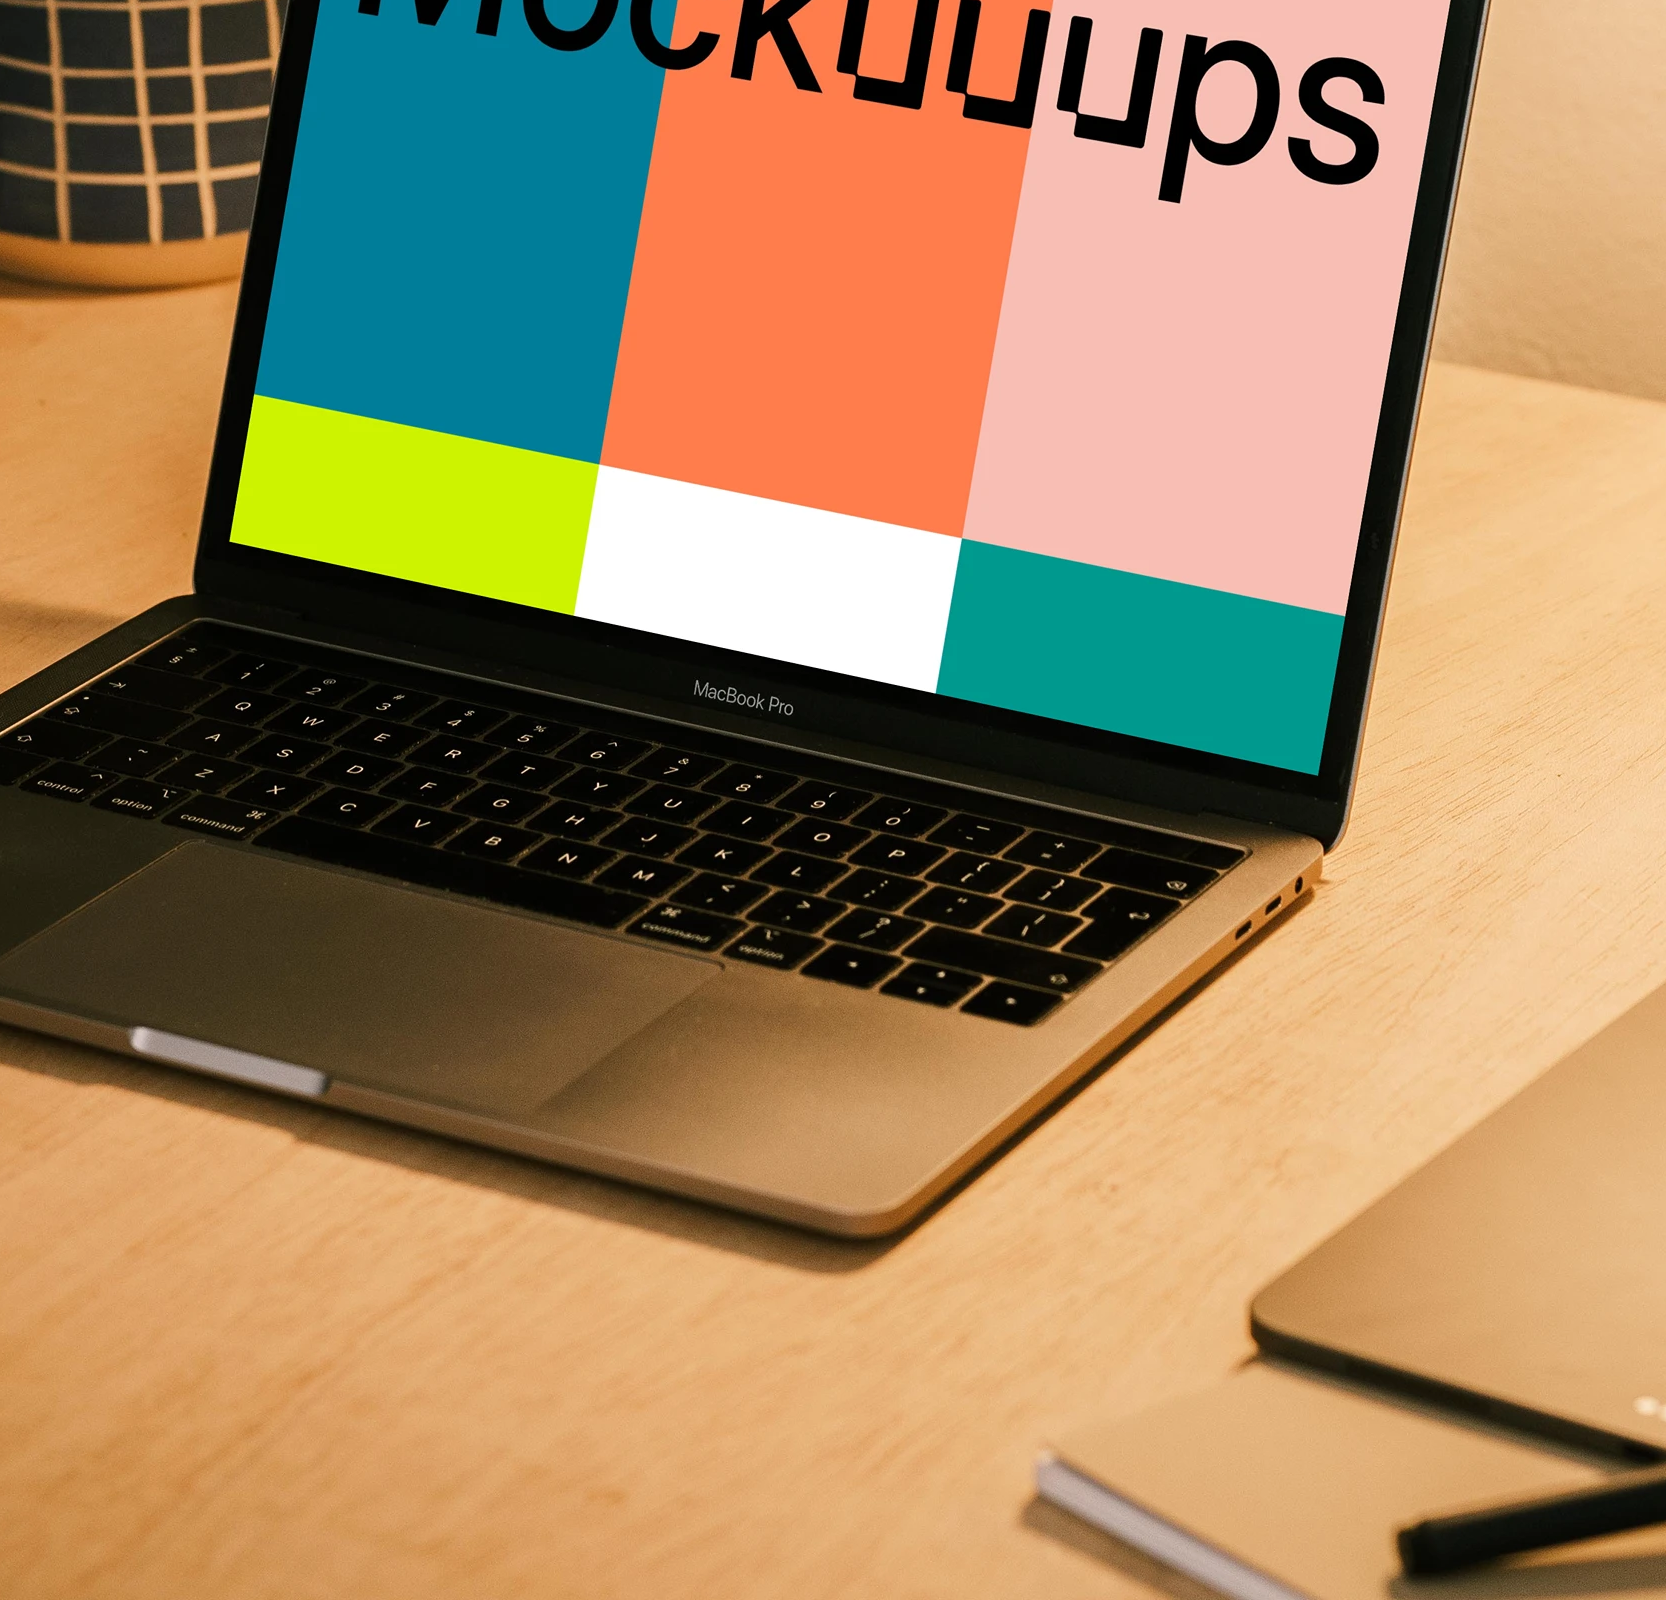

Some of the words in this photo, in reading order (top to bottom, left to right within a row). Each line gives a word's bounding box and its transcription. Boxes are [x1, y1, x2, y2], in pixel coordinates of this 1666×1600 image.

[240, 672, 251, 680] 1
[305, 686, 322, 696] 2
[375, 702, 392, 711] 3
[446, 719, 462, 727] 4
[516, 734, 534, 743] 5
[590, 750, 606, 759] 6
[663, 766, 680, 775] 7
[735, 783, 752, 792] 8
[810, 800, 826, 809] 9
[885, 816, 901, 826] 0
[693, 679, 766, 711] MacBook
[768, 695, 794, 716] Pro
[37, 780, 84, 795] control
[111, 798, 153, 811] option
[179, 813, 247, 834] command
[194, 768, 214, 778] Z
[265, 784, 286, 795] X
[339, 802, 357, 812] C
[414, 818, 431, 829] V
[484, 835, 502, 846] B
[557, 852, 578, 864] N
[632, 869, 655, 882] M
[204, 733, 221, 743] A
[276, 748, 294, 758] S
[346, 764, 364, 774] D
[419, 781, 438, 790] F
[492, 798, 510, 808] G
[564, 814, 585, 826] H
[640, 833, 658, 842] J
[714, 849, 733, 860] K
[790, 866, 802, 877] L
[234, 701, 252, 712] Q
[302, 716, 325, 727] W
[373, 732, 391, 743] E
[444, 749, 462, 759] R
[520, 765, 536, 775] T
[593, 781, 609, 791] Y
[663, 798, 683, 809] U
[741, 816, 753, 825] I
[813, 832, 831, 842] O
[887, 849, 906, 858] P
